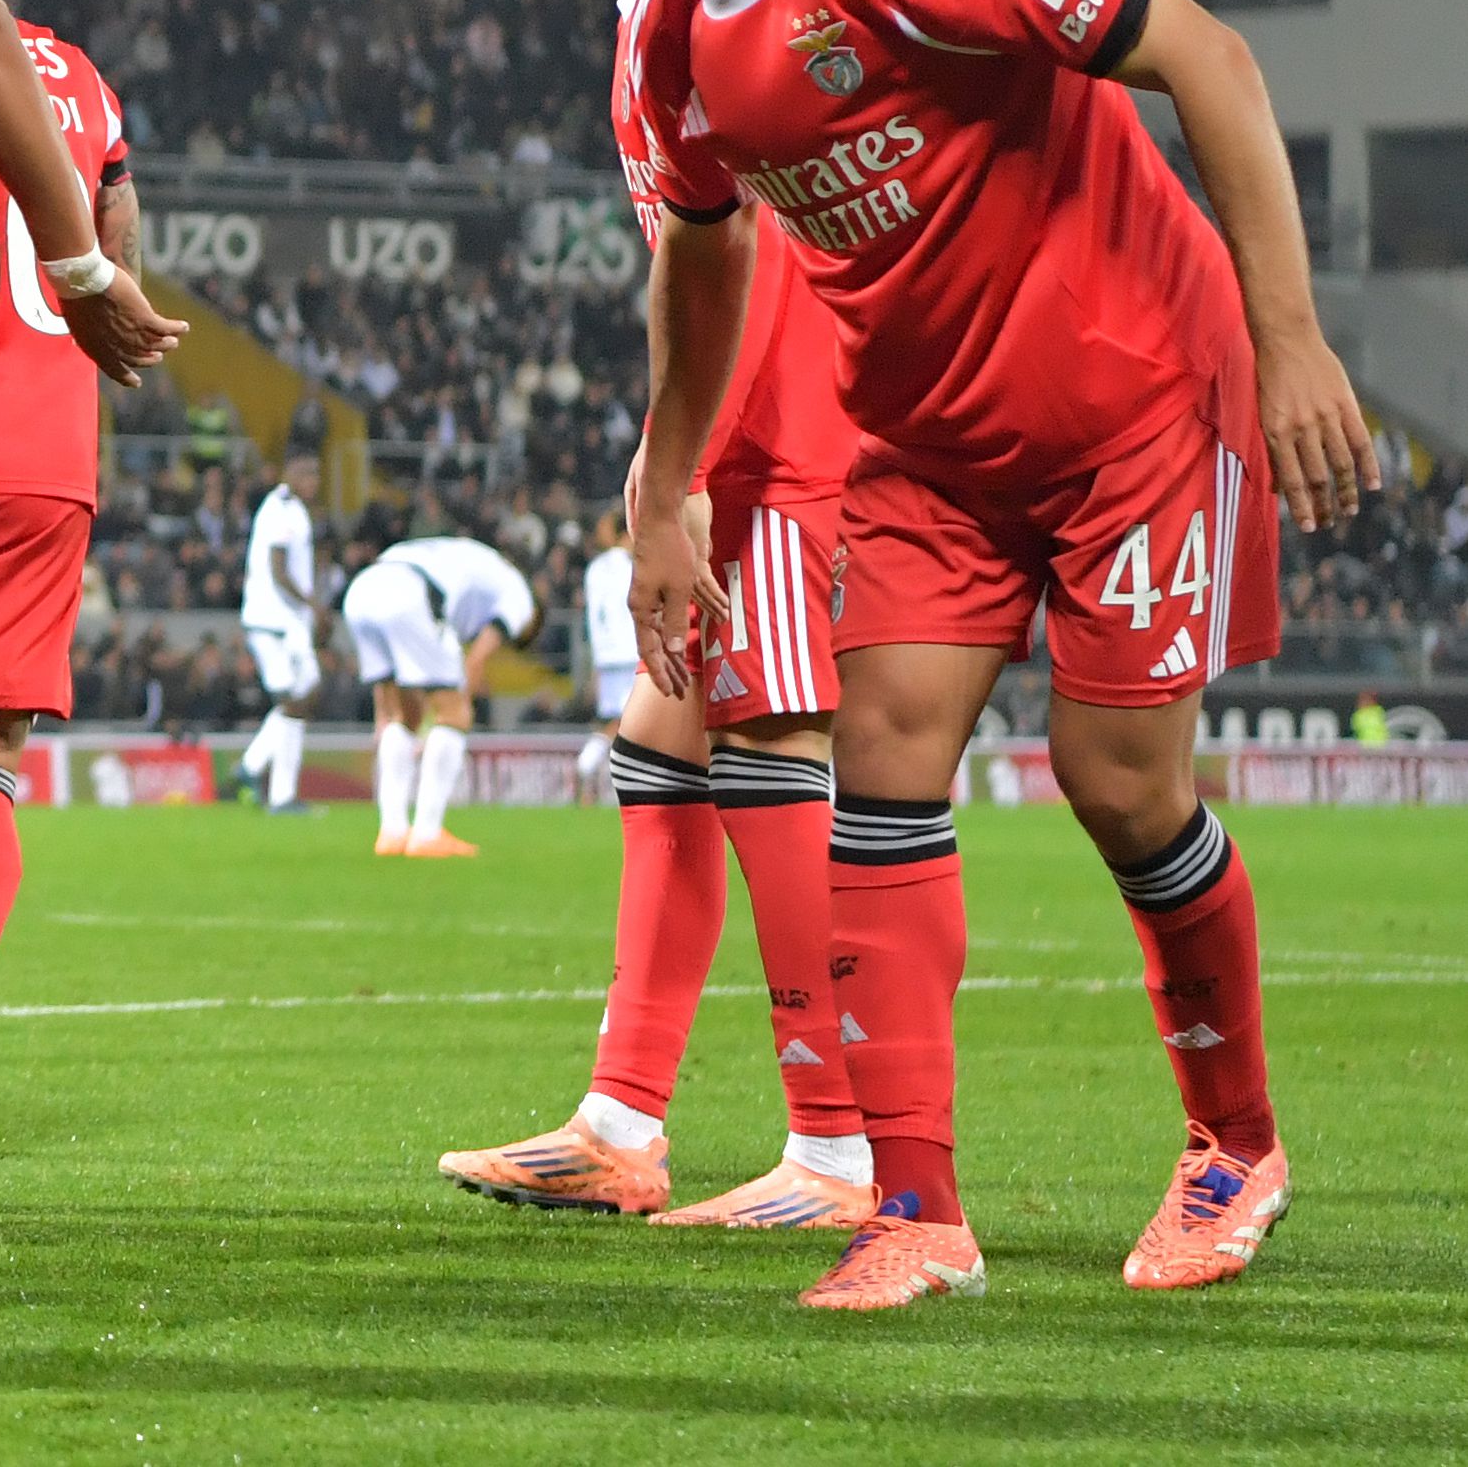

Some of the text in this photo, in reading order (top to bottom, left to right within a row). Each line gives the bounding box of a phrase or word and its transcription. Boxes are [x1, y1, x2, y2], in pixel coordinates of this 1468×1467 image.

[731, 113, 925, 210] mirates
[142, 212, 263, 277] UZO
[328, 218, 455, 283] UZO
[803, 178, 921, 251] BETTER
[1099, 510, 1212, 631] 44
